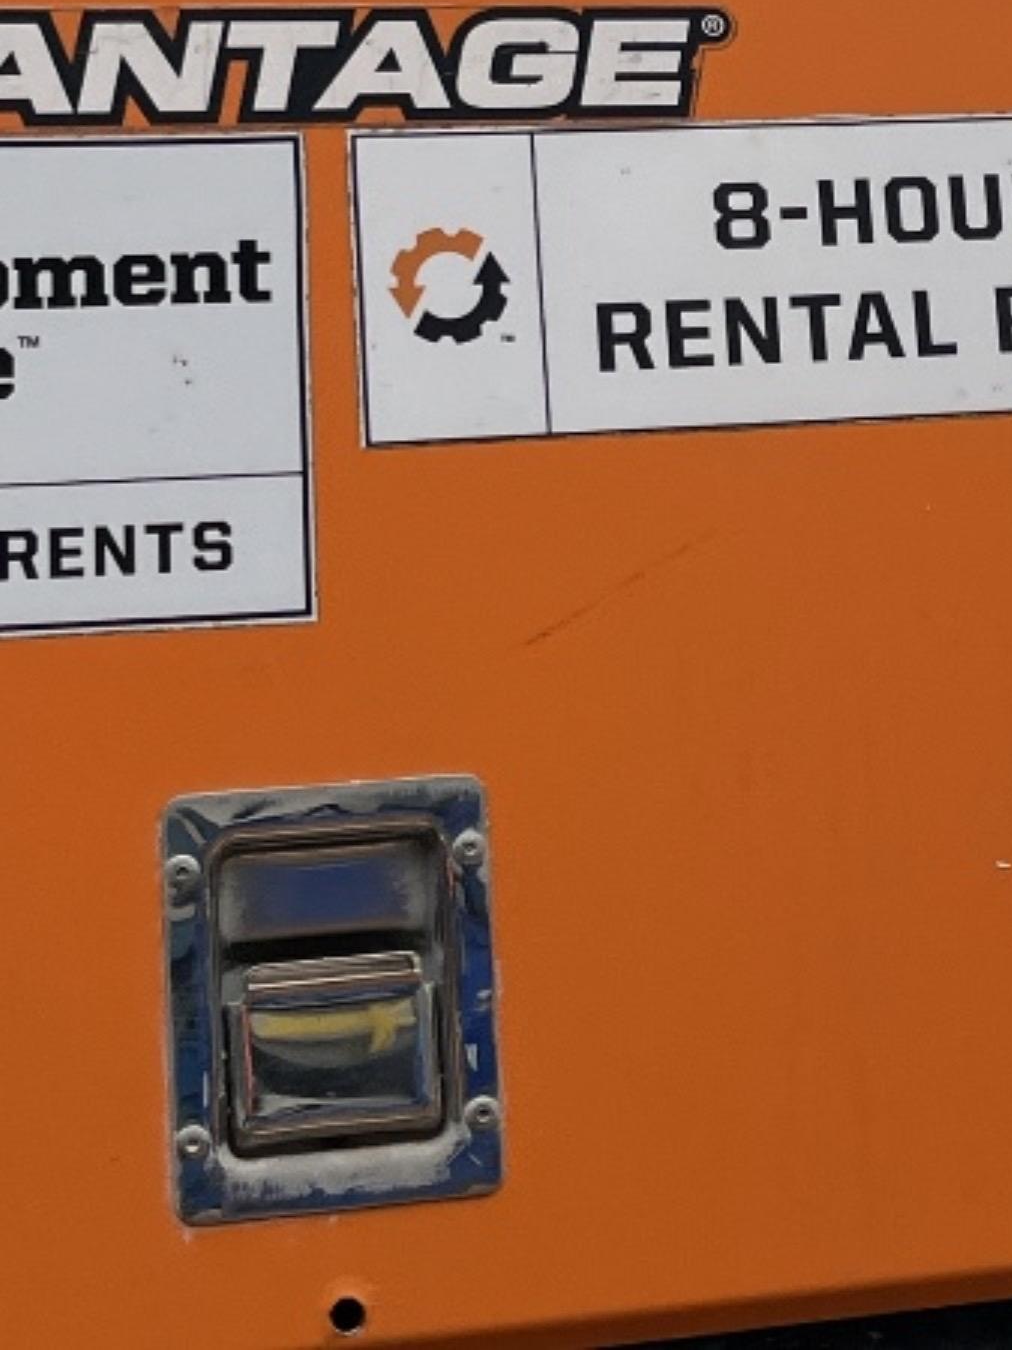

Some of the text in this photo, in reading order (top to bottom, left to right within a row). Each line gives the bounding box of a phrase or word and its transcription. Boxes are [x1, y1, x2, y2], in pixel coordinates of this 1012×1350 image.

[0, 240, 271, 309] ment
[597, 291, 957, 371] RENTAL
[0, 522, 231, 581] RENTS
